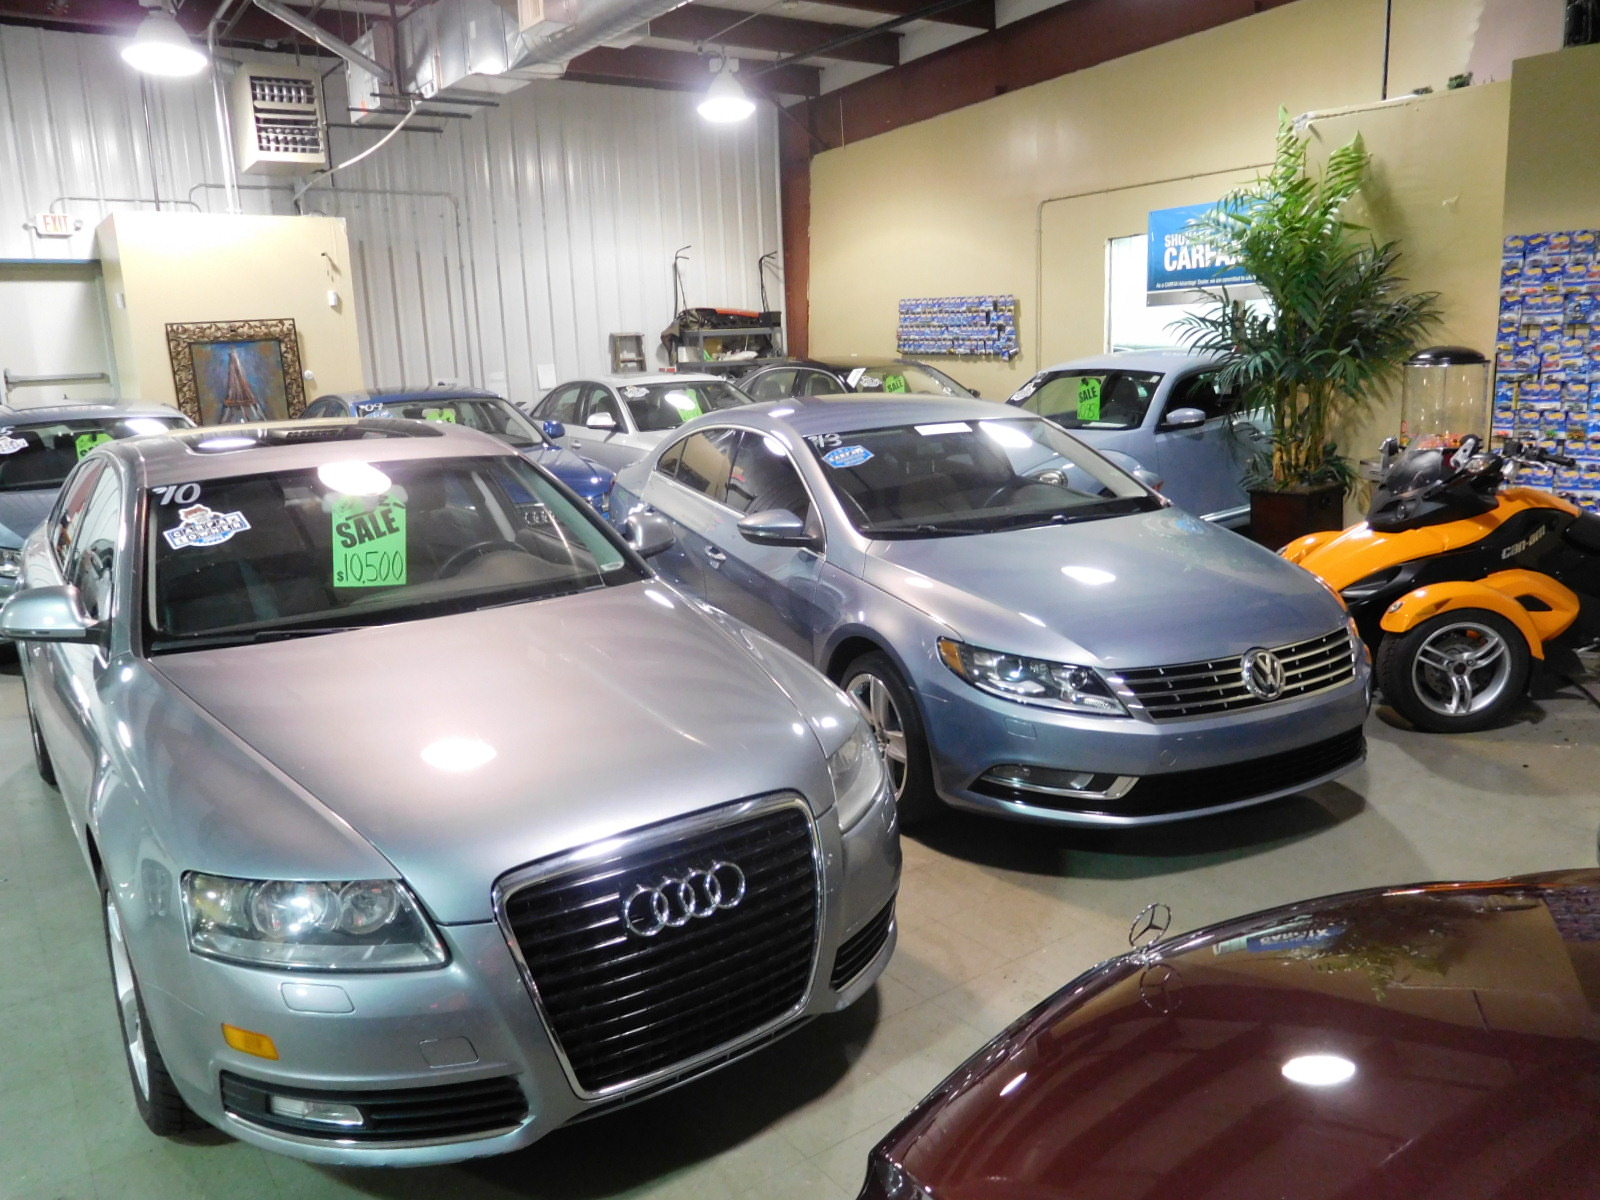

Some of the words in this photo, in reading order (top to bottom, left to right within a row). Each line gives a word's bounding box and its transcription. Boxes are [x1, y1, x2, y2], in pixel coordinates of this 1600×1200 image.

[42, 214, 69, 233] EXIT
[1078, 386, 1098, 404] SALE
[335, 508, 400, 549] SALE
